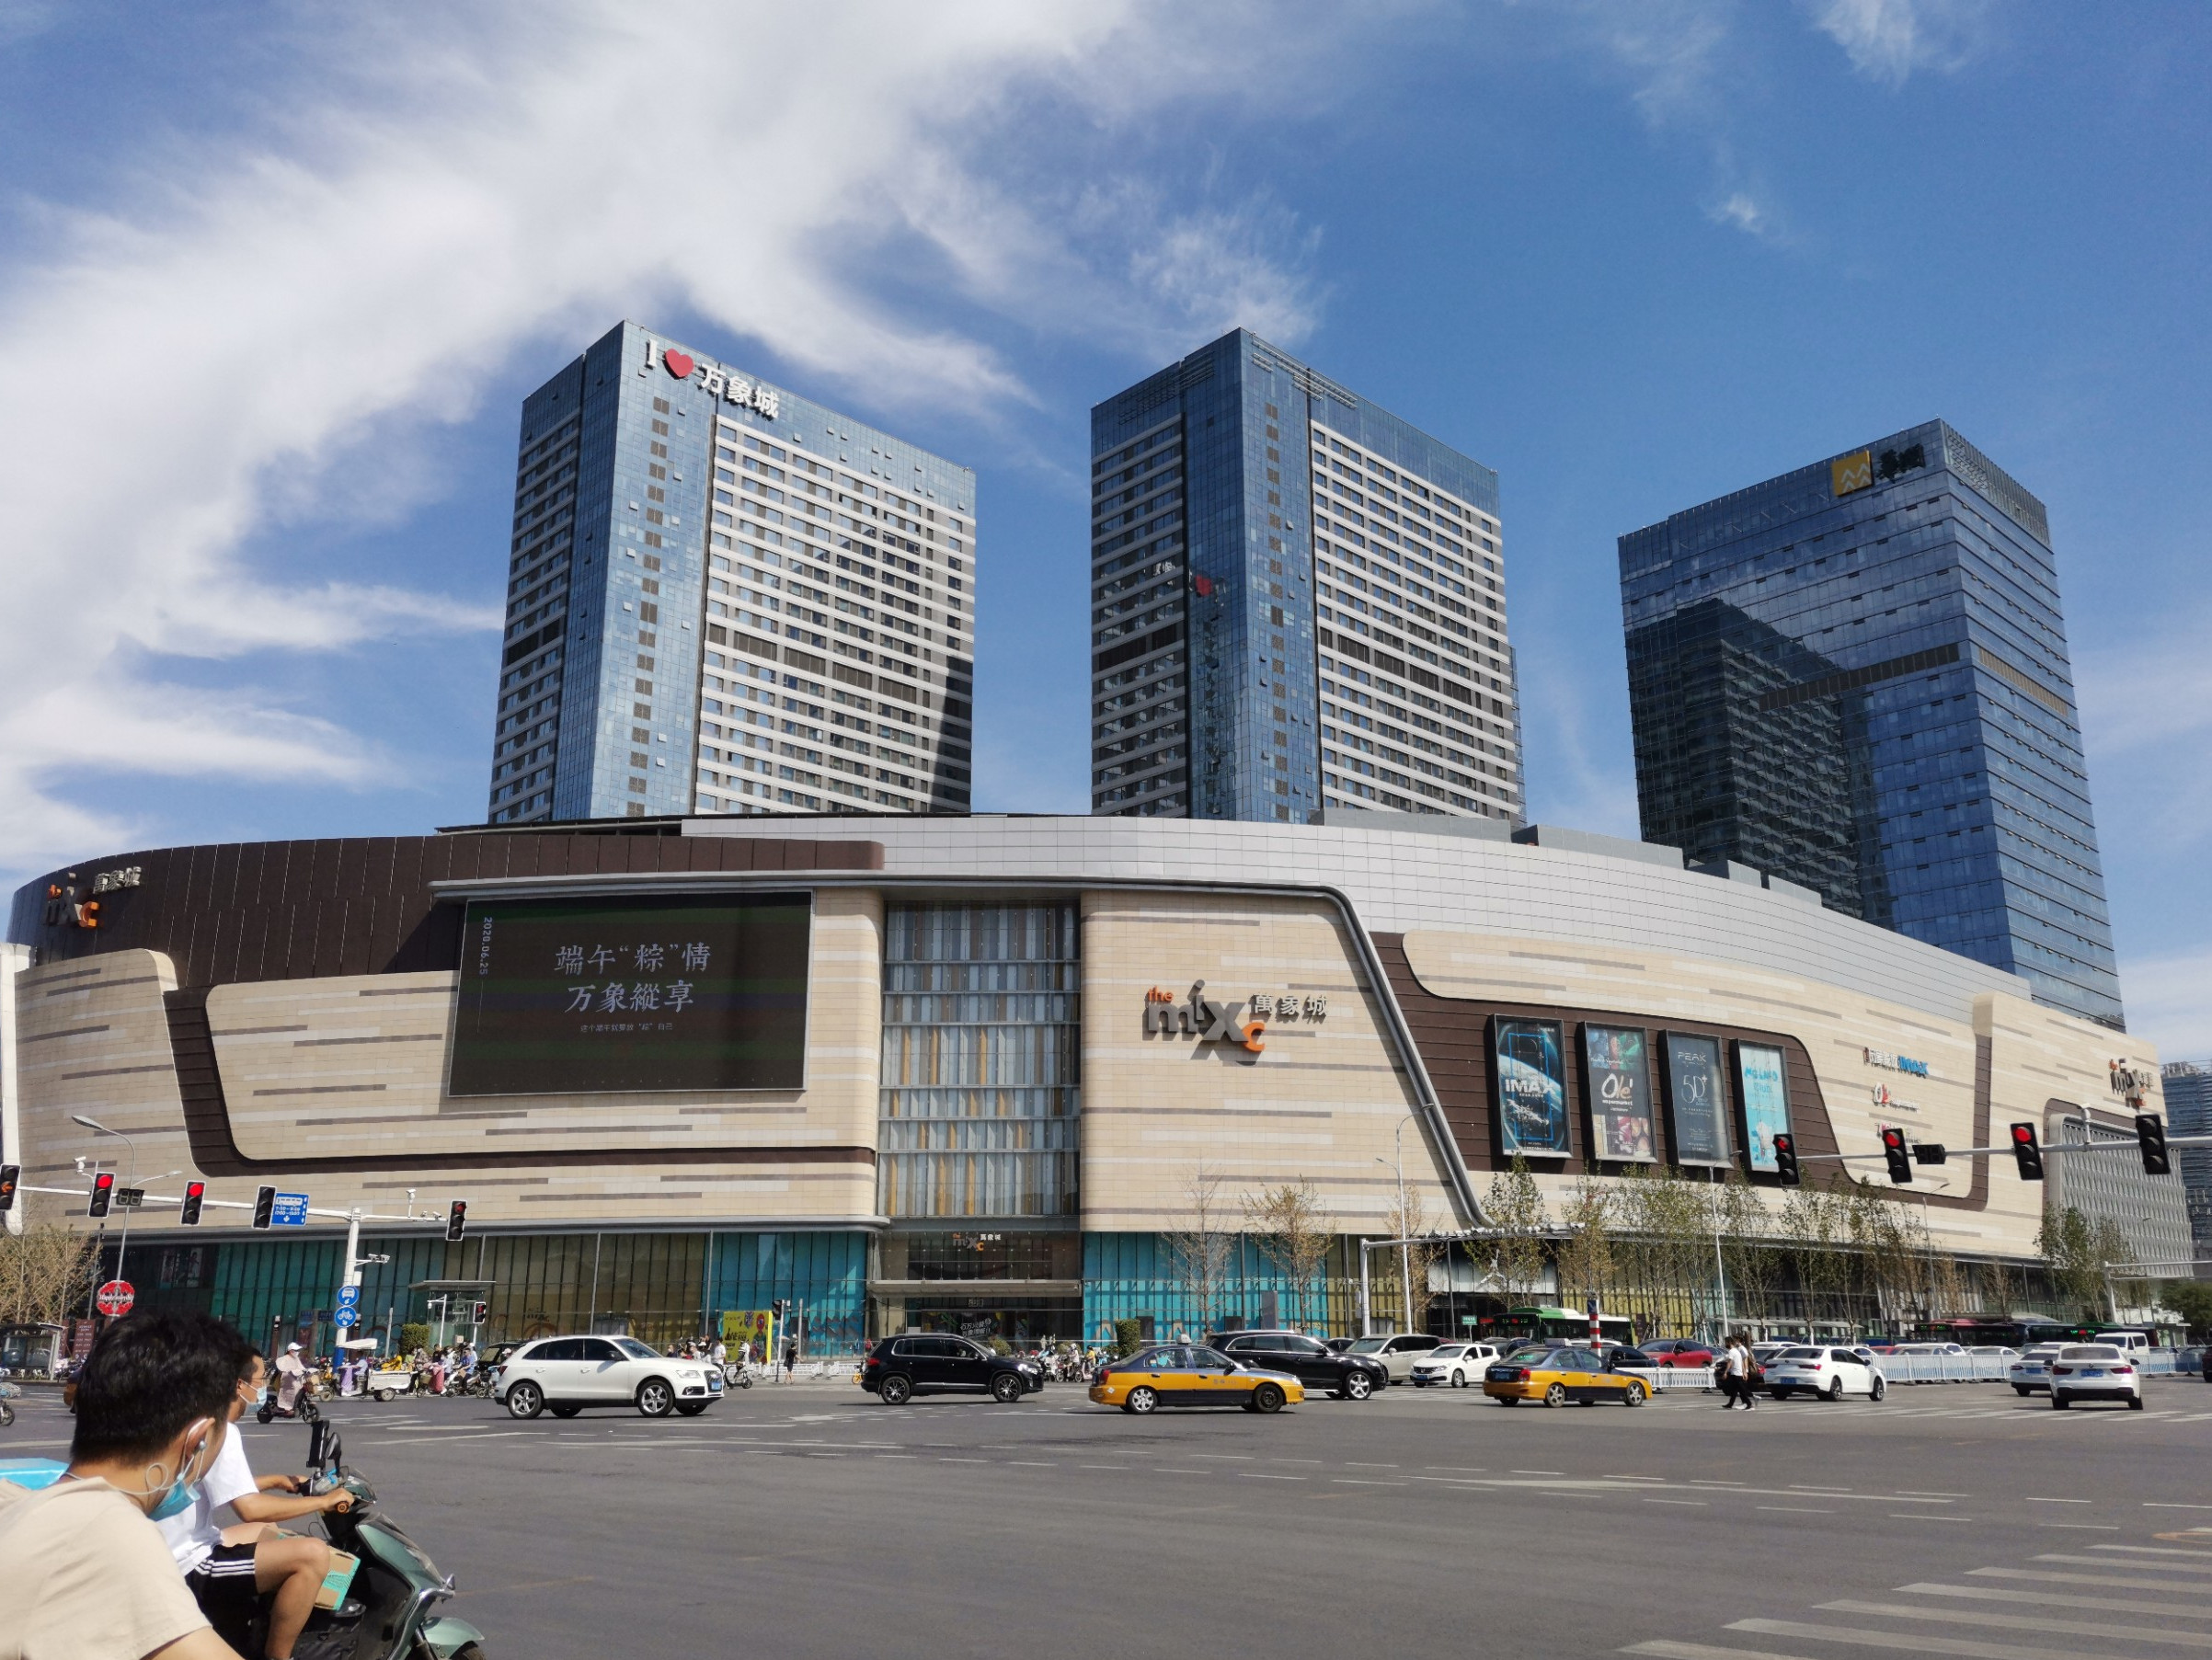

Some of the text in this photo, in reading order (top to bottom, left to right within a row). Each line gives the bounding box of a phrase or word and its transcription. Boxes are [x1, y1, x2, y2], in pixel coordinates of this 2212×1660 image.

[648, 338, 659, 368] I
[701, 362, 780, 419] 万象城
[479, 916, 493, 975] 2020.06.25
[1148, 986, 1175, 1002] the
[1254, 993, 1327, 1016] 萬象城
[1678, 1051, 1707, 1062] PEAK
[1505, 1078, 1556, 1094] IMAX
